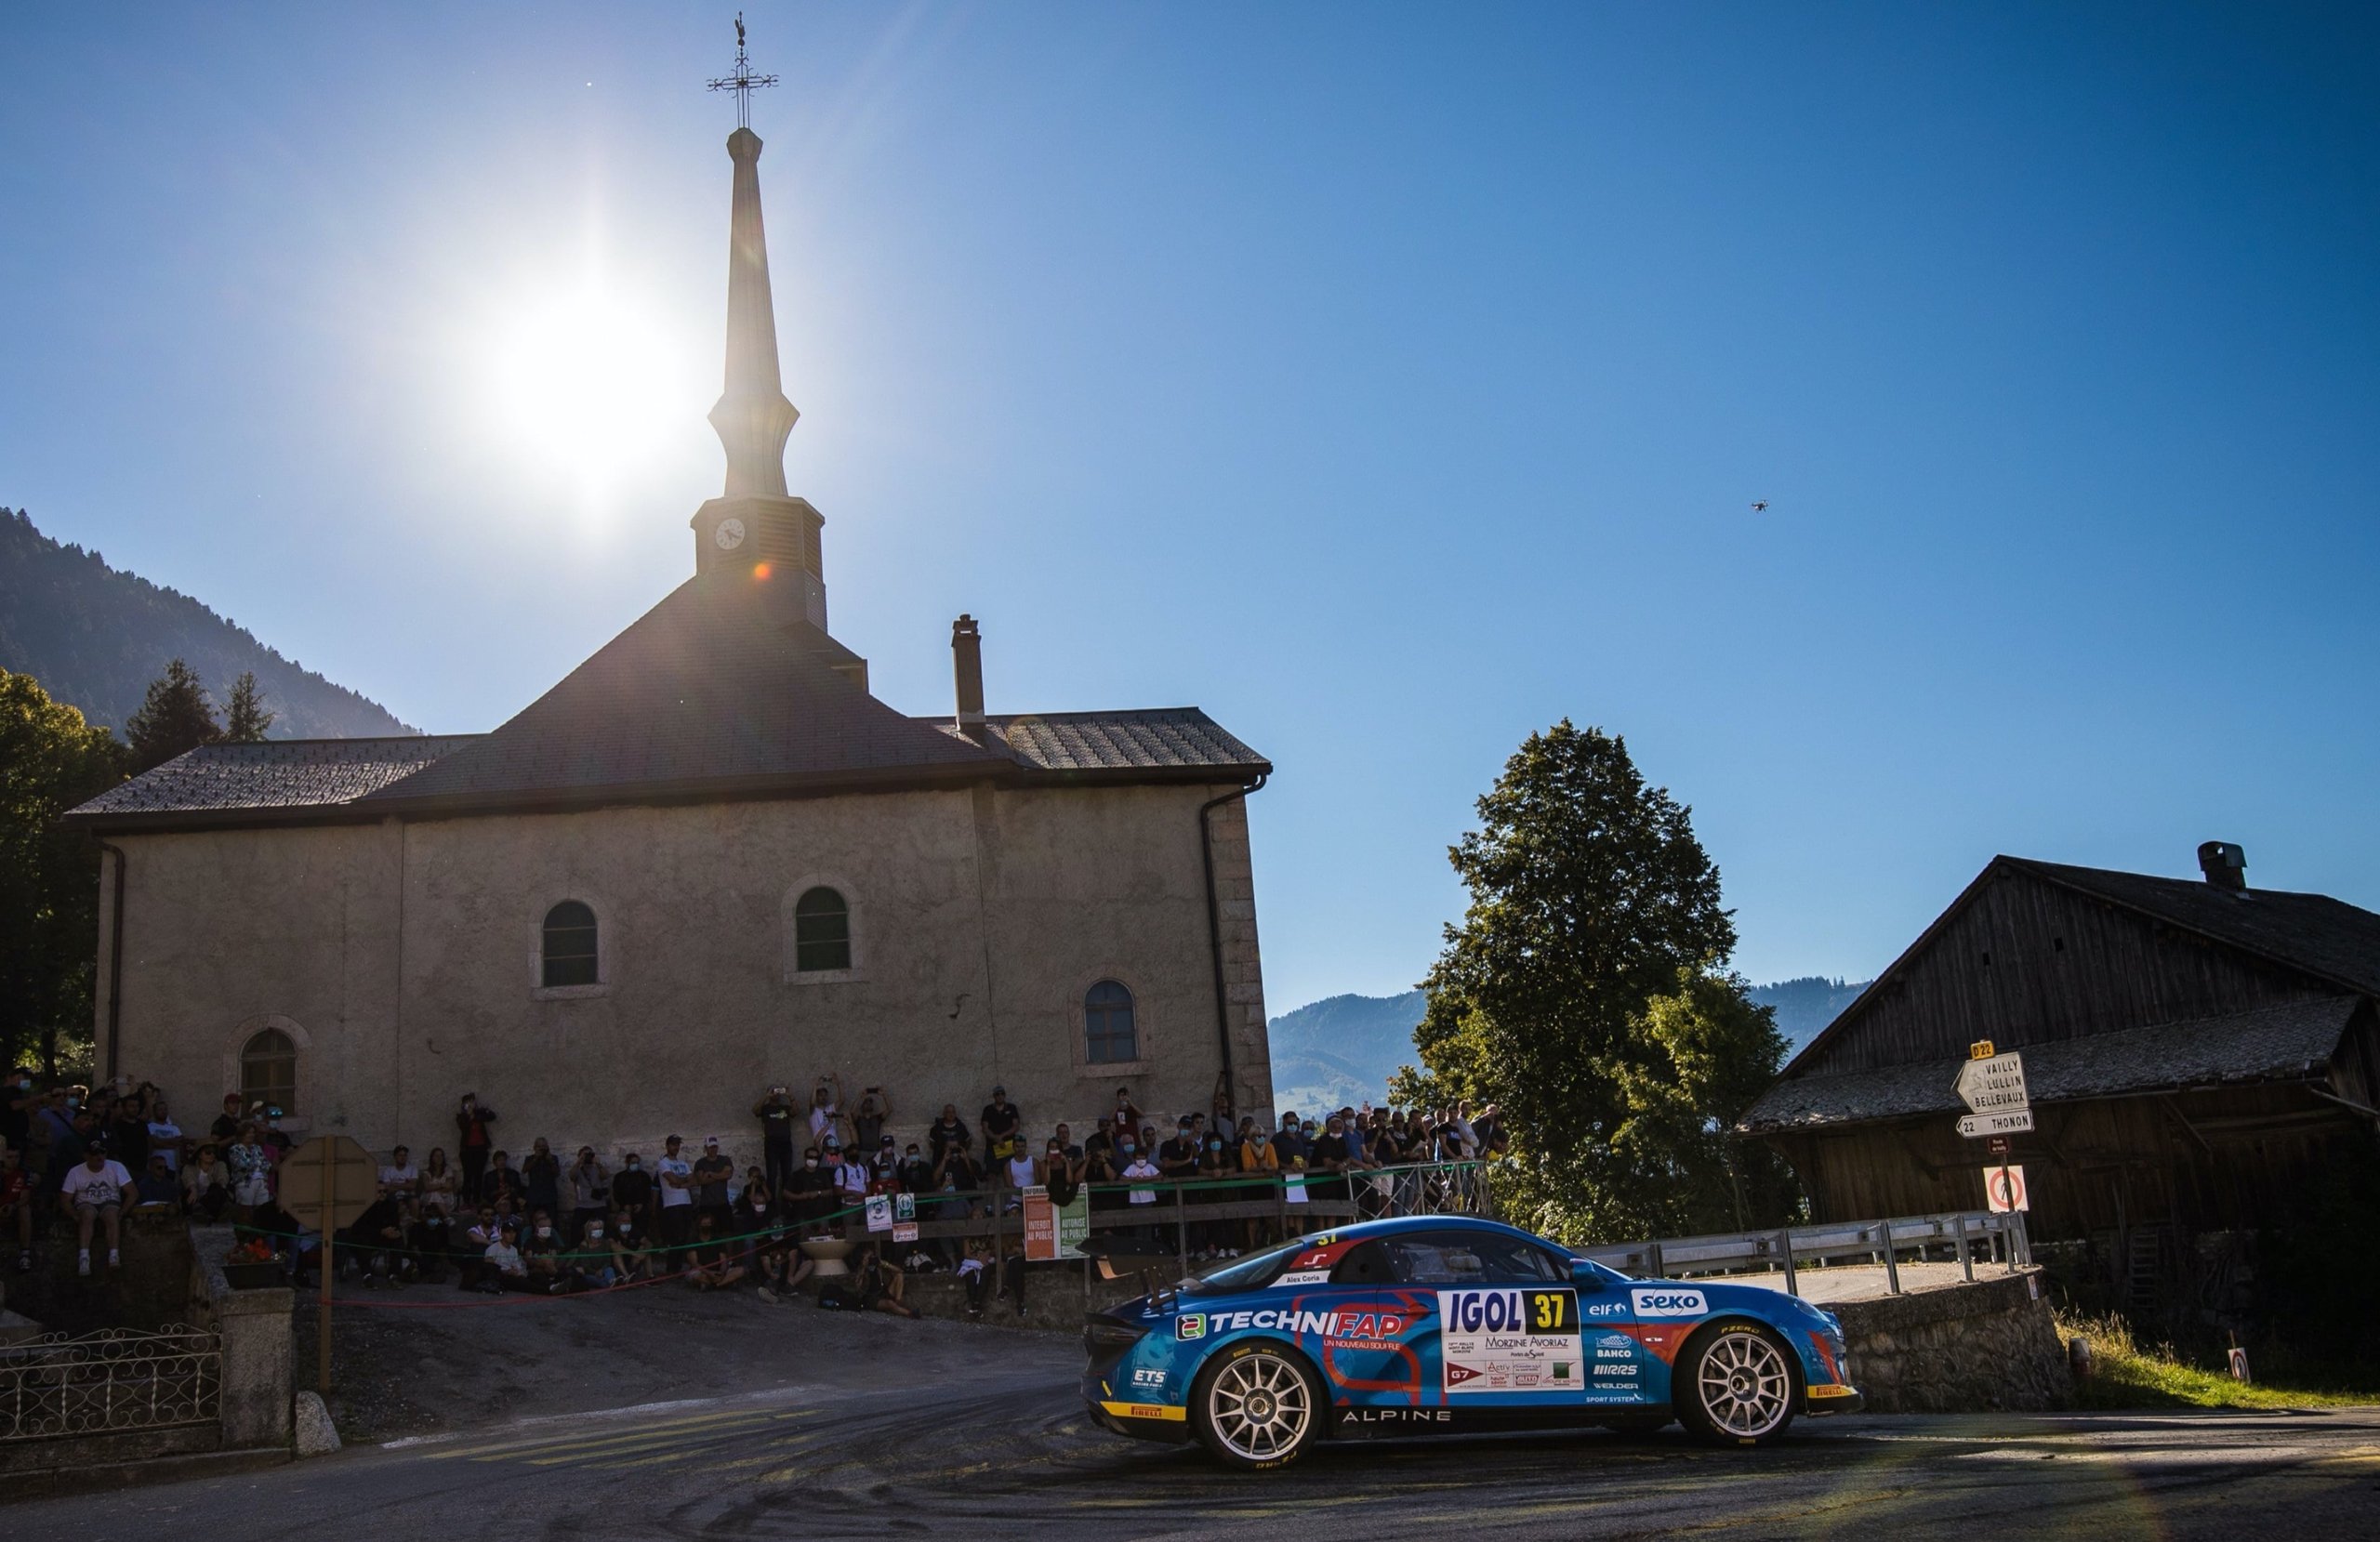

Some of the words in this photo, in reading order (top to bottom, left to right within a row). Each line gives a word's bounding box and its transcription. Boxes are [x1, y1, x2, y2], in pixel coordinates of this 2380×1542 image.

[1973, 1047, 1979, 1057] D
[1980, 1044, 1991, 1056] 22
[1985, 1060, 2018, 1075] VAILLY
[1987, 1075, 2022, 1090] LULLIN
[1975, 1091, 2025, 1108] BELLEVAUX
[1964, 1121, 1976, 1133] 22
[1991, 1114, 2029, 1129] THONON
[1028, 1219, 1051, 1231] INTERDIT
[1027, 1231, 1035, 1241] AU
[1035, 1230, 1053, 1241] PUBLIC
[1286, 1275, 1302, 1284] Alex
[1448, 1292, 1522, 1334] IGOL
[1535, 1294, 1565, 1328] 37
[1589, 1303, 1612, 1316] elf
[1210, 1310, 1402, 1340] TECHNIFAP
[1335, 1340, 1369, 1349] NOUVEAU
[1370, 1341, 1400, 1351] SOUFFLE
[1485, 1337, 1527, 1348] MORZINE
[1529, 1336, 1569, 1348] AVORIAZ
[1597, 1350, 1633, 1358] BAHCO
[1488, 1361, 1510, 1373] Activ
[1134, 1369, 1167, 1383] ETS
[1450, 1370, 1470, 1379] G7
[1130, 1405, 1162, 1417] PIRELLI
[1342, 1410, 1451, 1423] ALPINE
